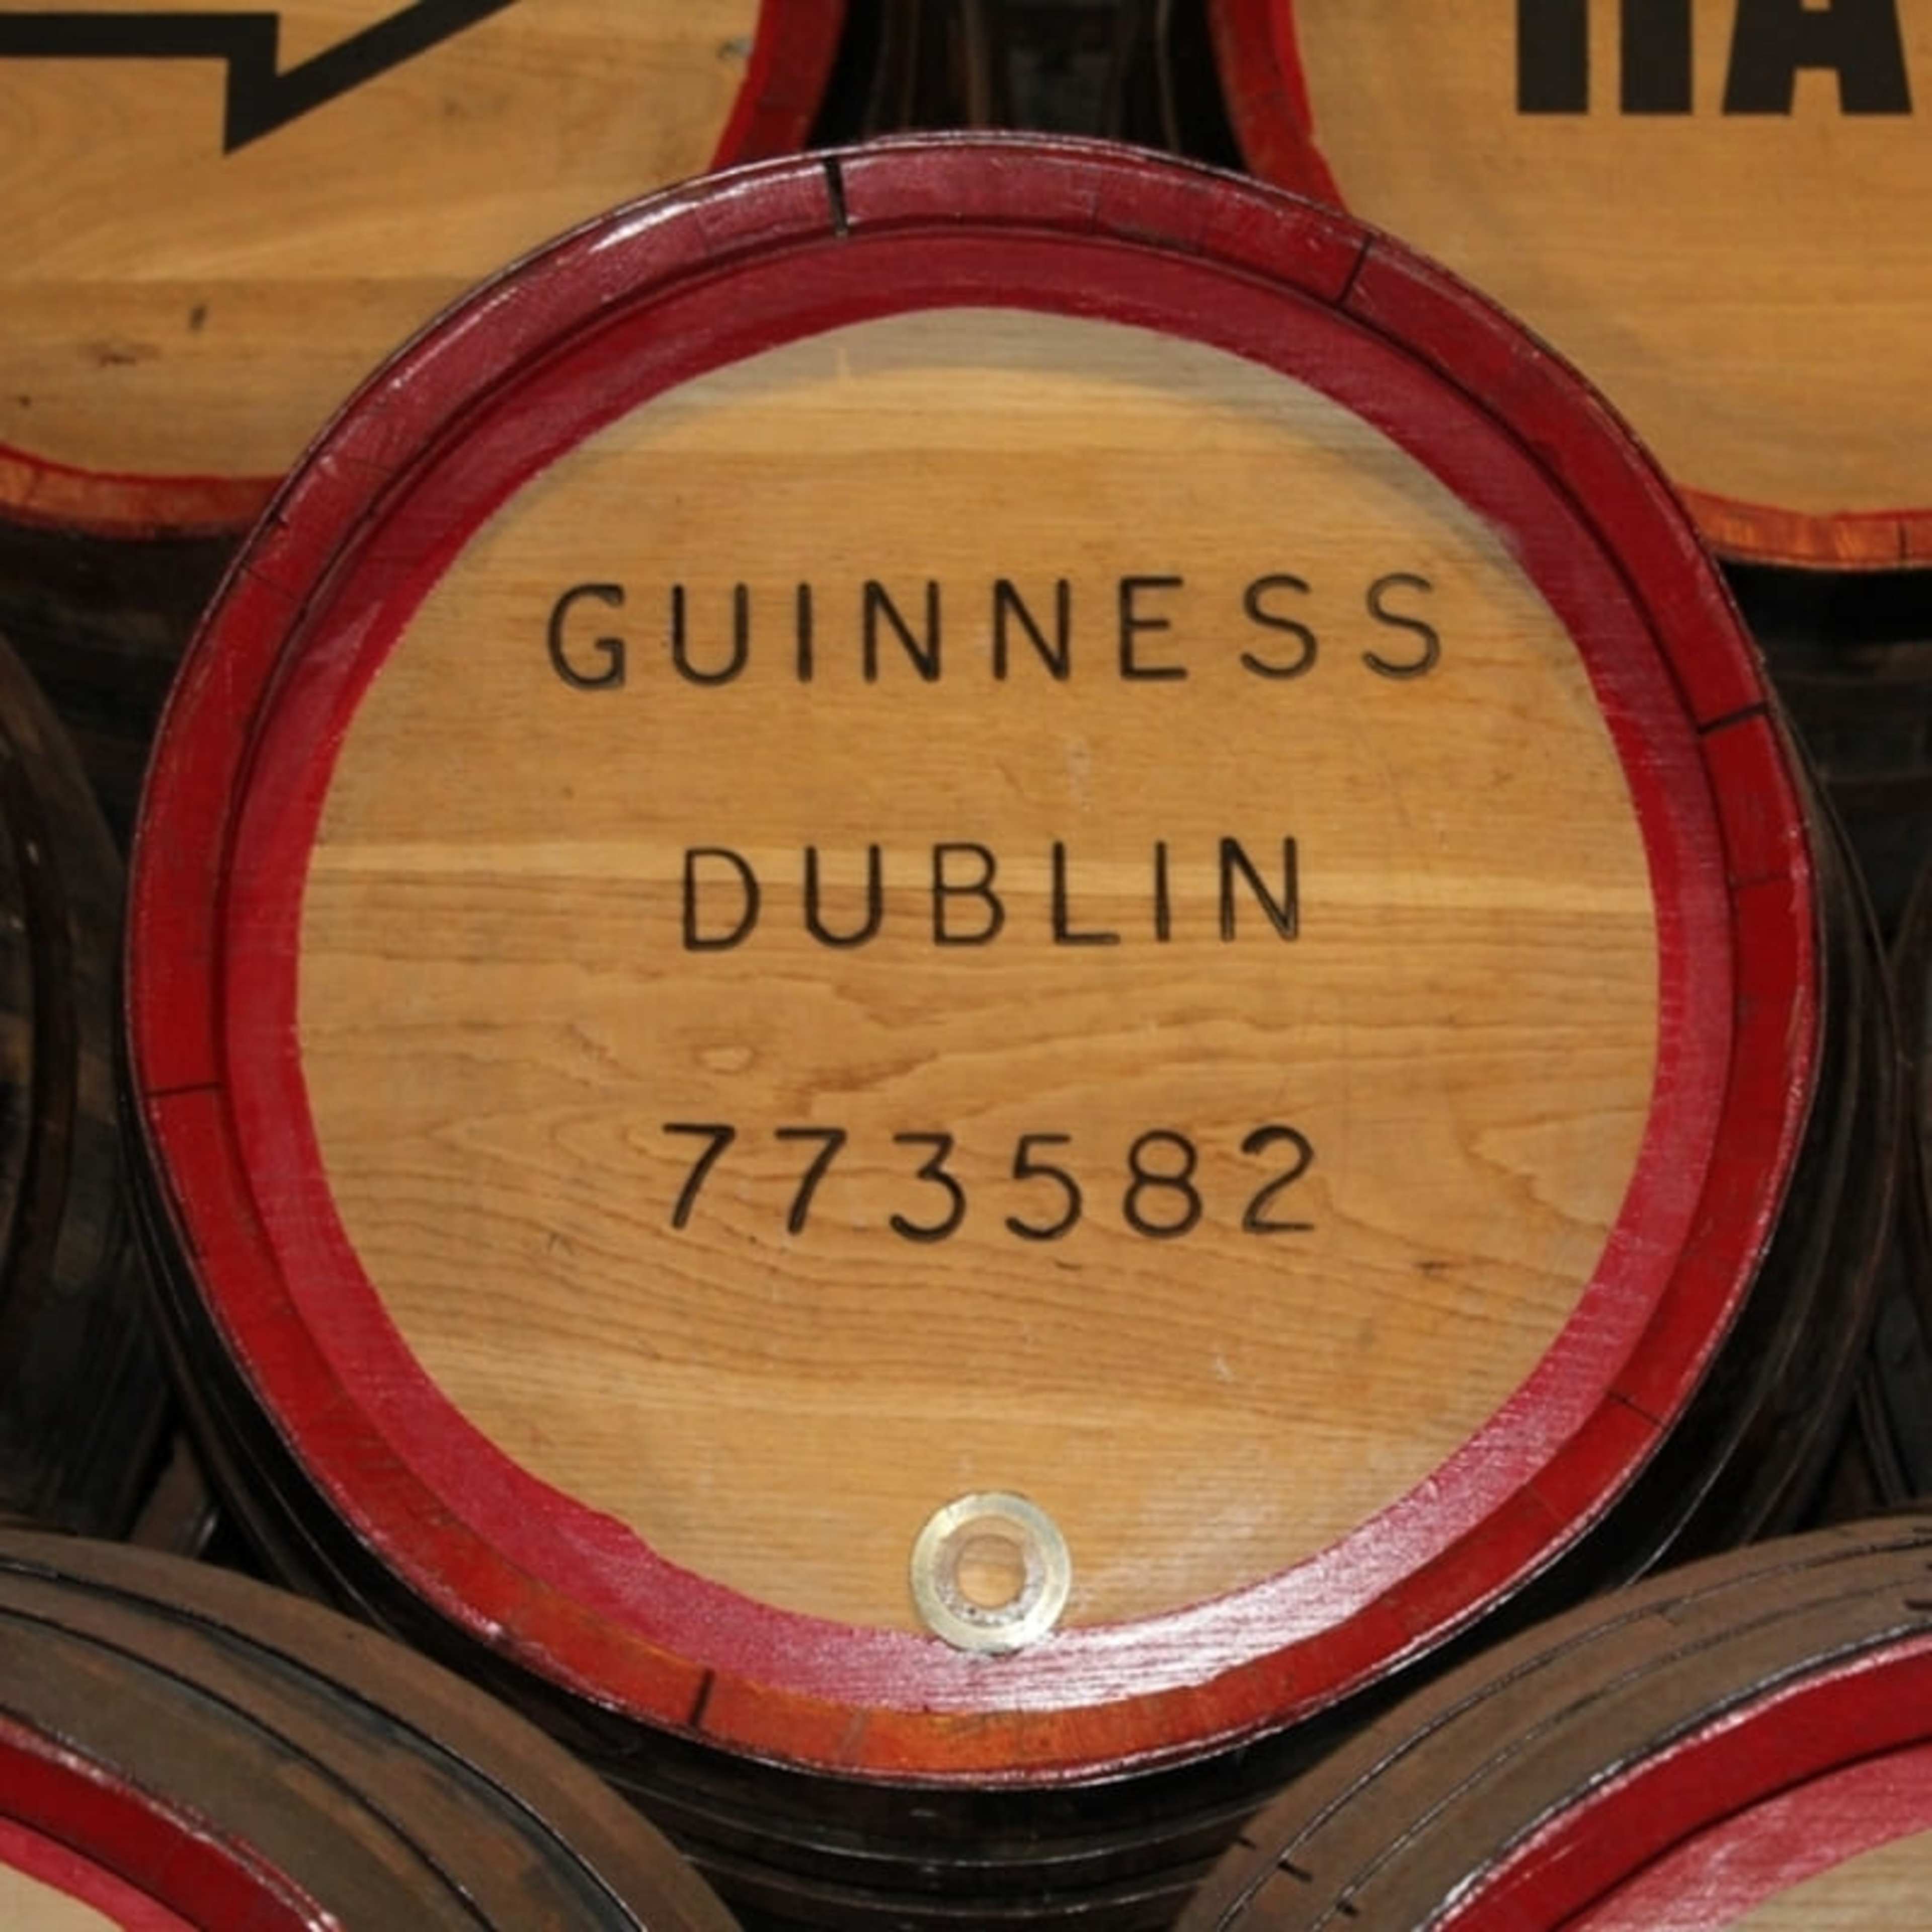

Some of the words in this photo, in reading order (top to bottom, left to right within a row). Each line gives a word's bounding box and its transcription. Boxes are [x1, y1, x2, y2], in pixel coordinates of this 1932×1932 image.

[546, 573, 1440, 690] GUINNESS
[682, 837, 1299, 951] DUBLIN
[663, 1123, 1314, 1243] 773582
